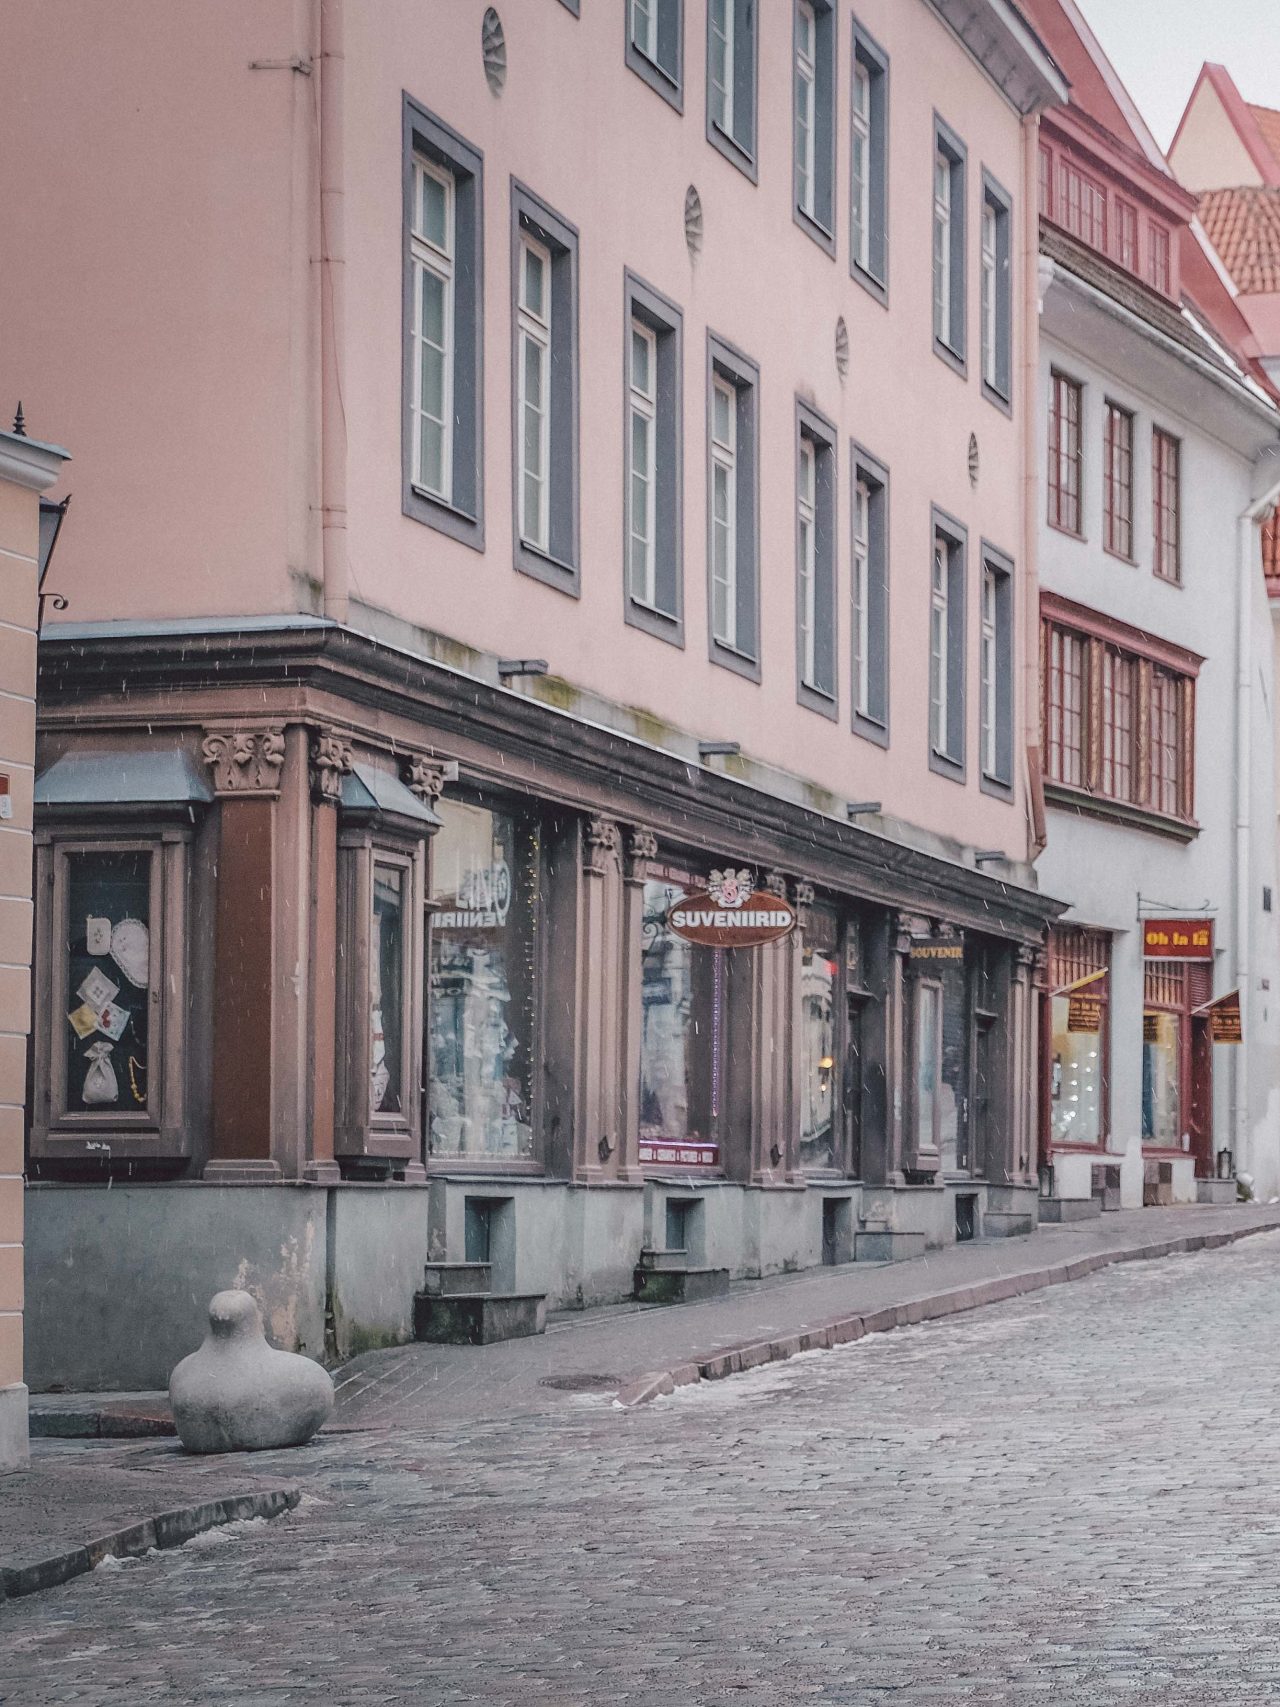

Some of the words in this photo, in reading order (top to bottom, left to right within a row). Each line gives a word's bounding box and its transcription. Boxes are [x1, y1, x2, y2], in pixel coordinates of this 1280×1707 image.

[671, 910, 792, 928] SUVENIIRID
[1146, 931, 1168, 945] Oh
[1173, 931, 1189, 946] la
